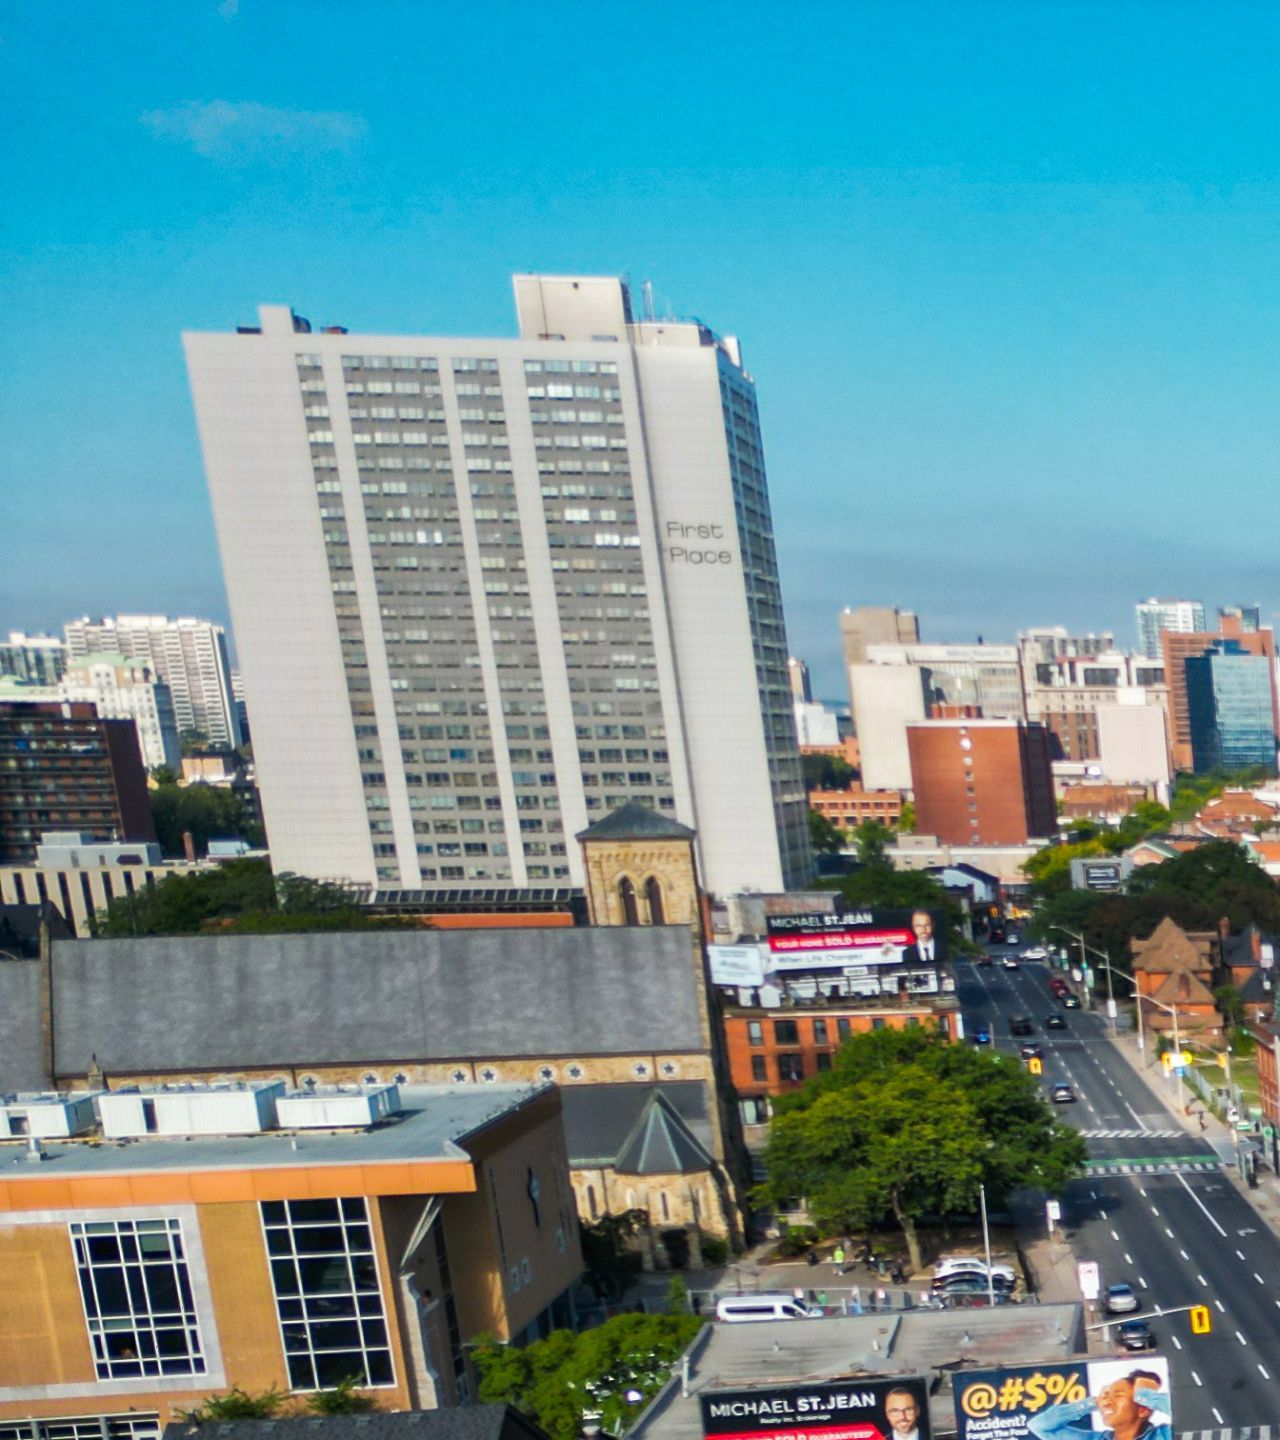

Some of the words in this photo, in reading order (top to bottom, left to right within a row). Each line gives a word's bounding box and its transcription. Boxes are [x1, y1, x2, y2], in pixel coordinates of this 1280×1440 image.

[666, 521, 724, 540] First
[670, 547, 732, 565] Place
[770, 916, 823, 928] MICHAEL
[775, 940, 799, 949] YOUR
[801, 938, 824, 947] HOME
[825, 936, 852, 946] SOLD
[710, 1399, 794, 1418] MICHAEL
[966, 1414, 1027, 1432] Accident?
[995, 1429, 1009, 1438] The
[1010, 1428, 1030, 1437] Four
